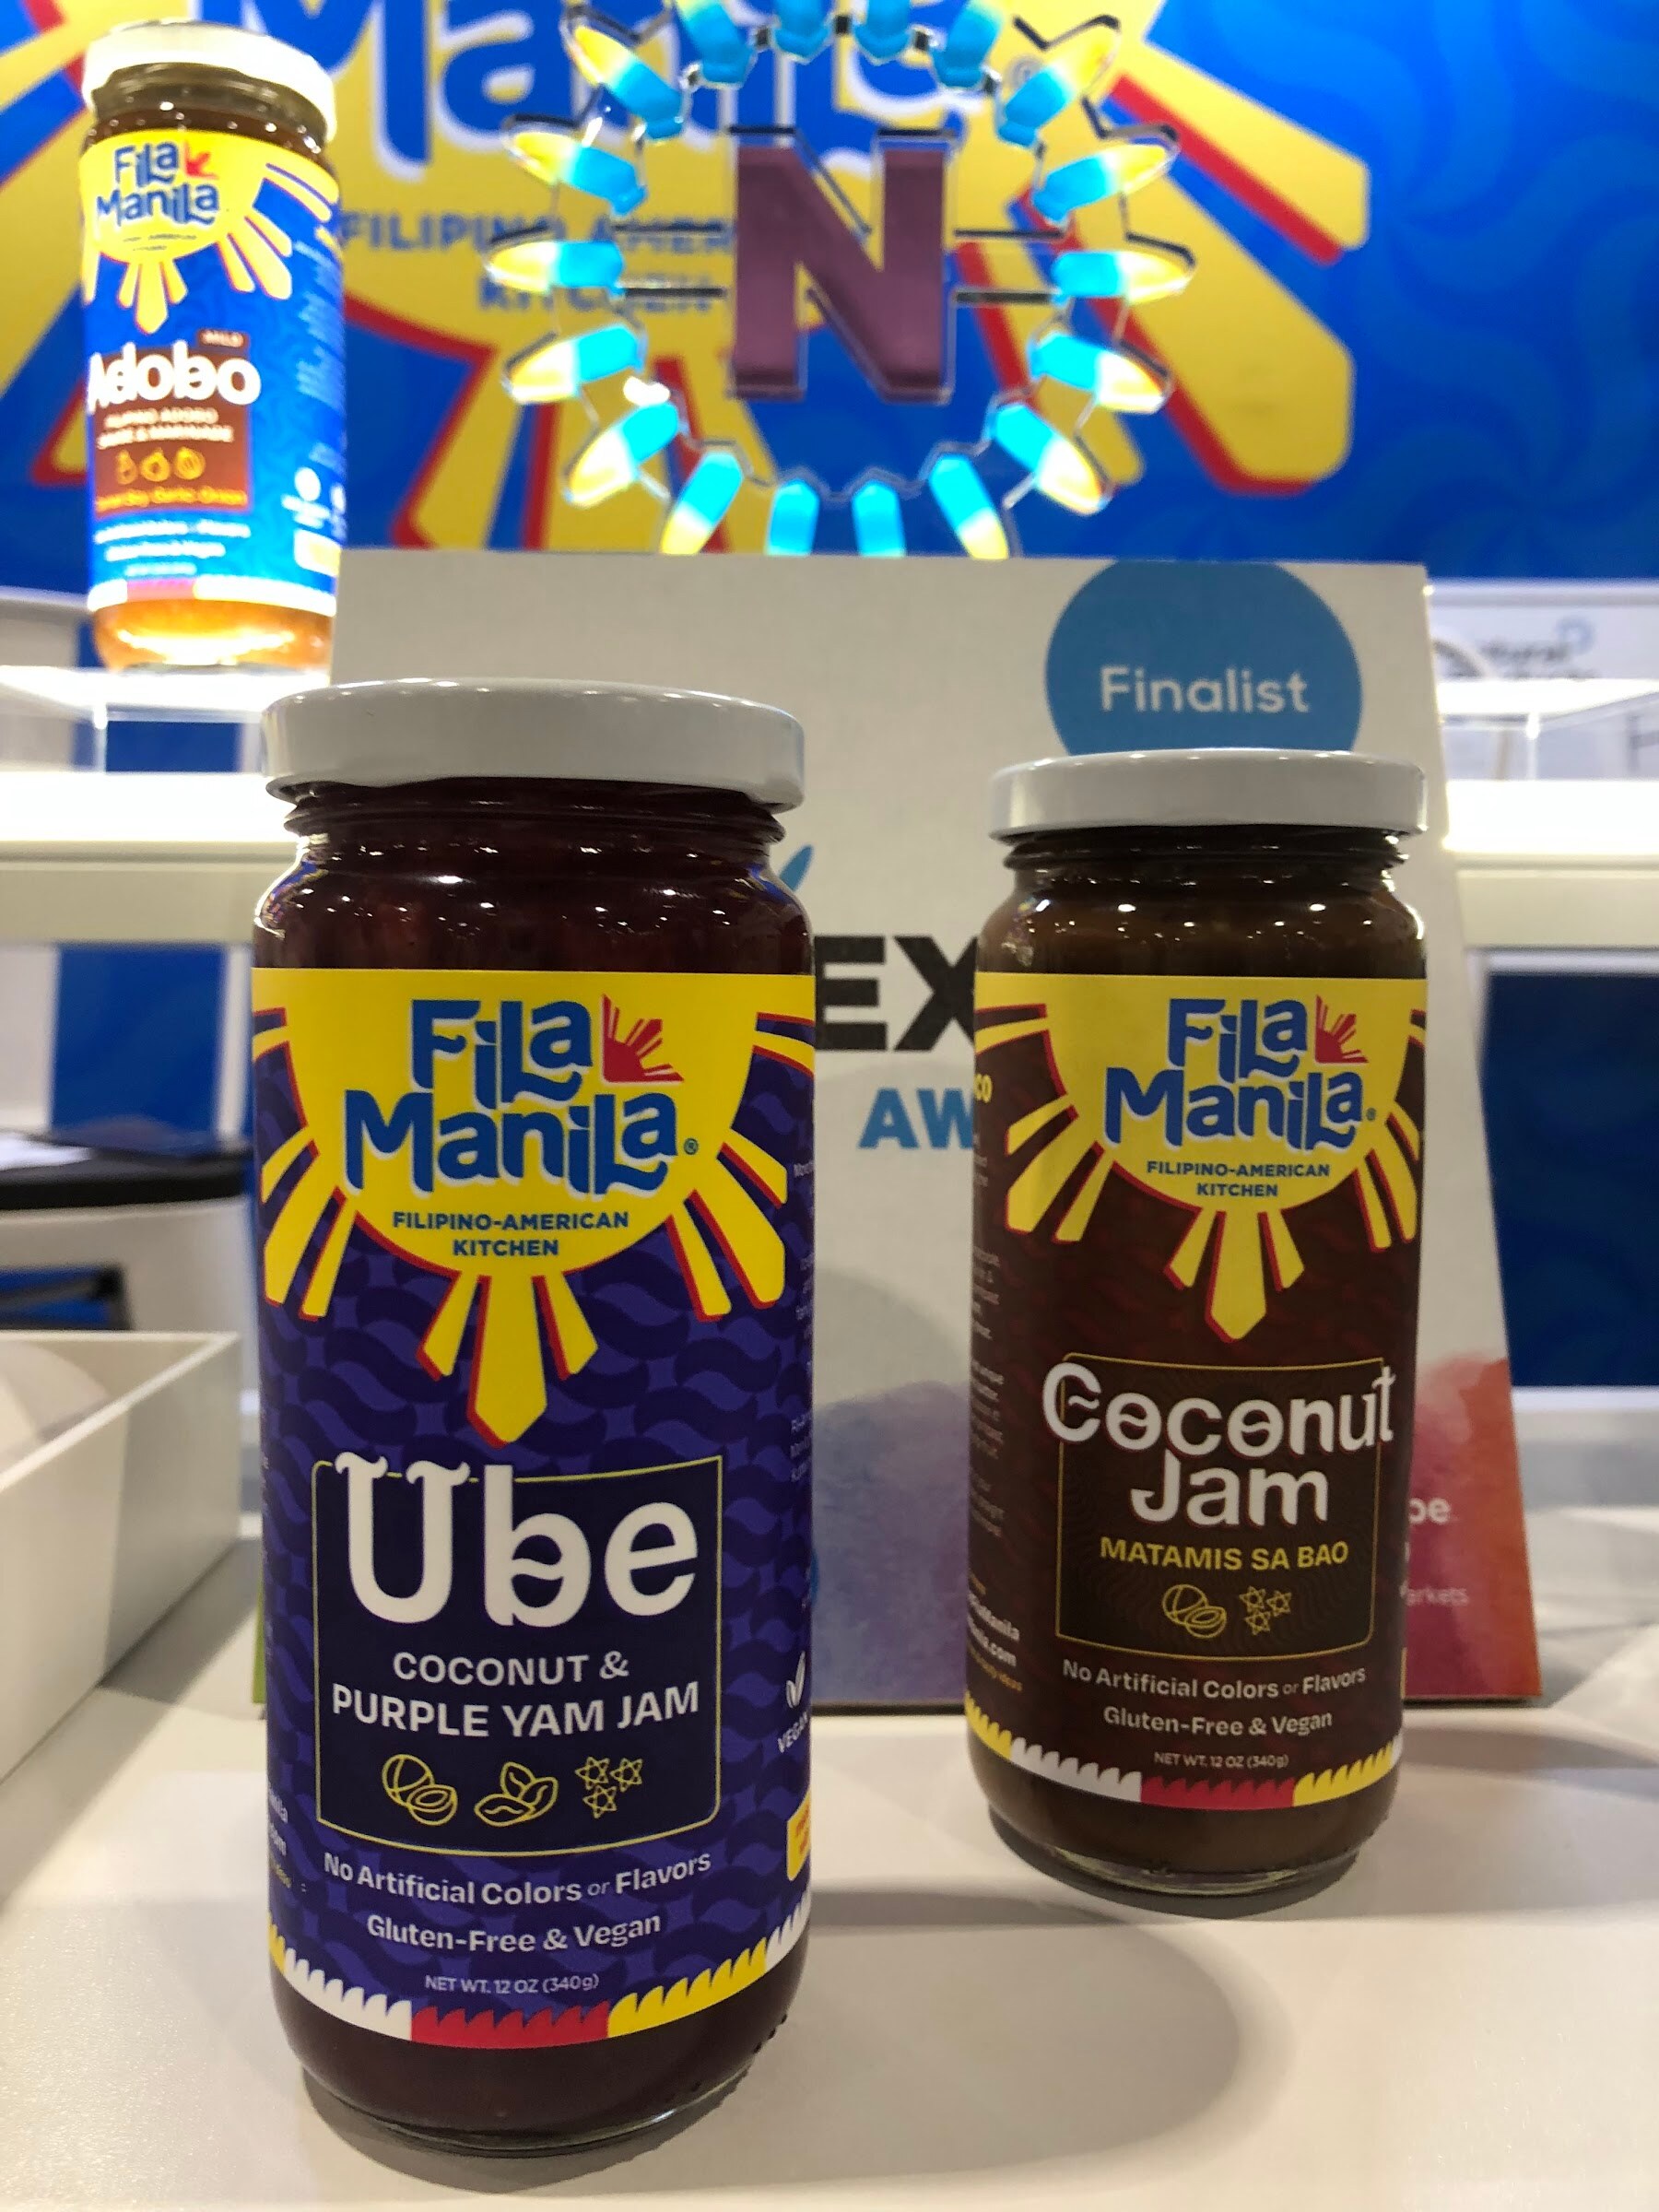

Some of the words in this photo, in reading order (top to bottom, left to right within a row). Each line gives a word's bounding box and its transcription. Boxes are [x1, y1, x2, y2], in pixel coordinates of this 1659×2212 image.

[1100, 666, 1311, 714] Finalist
[1146, 1160, 1331, 1178] FILIPINO-AMERICAN
[1196, 1182, 1279, 1197] KITCHEN
[393, 1210, 630, 1231] FILIPINO-AMERICAN
[452, 1239, 559, 1257] KITCHEN
[1042, 1361, 1396, 1459] Coconut
[1130, 1448, 1329, 1527] Jam
[335, 1452, 700, 1628] Ube
[1100, 1535, 1243, 1571] MATAMIS
[1251, 1547, 1290, 1571] SA
[1298, 1540, 1349, 1569] BAO
[393, 1652, 590, 1687] COCONUT
[599, 1650, 630, 1680] &
[1063, 1659, 1093, 1683] No
[1096, 1668, 1198, 1699] Artificial
[1203, 1679, 1280, 1700] Colors
[1282, 1683, 1300, 1696] or
[1302, 1665, 1367, 1696] Flavors
[333, 1682, 490, 1738] PURPLE
[502, 1699, 606, 1738] YAM
[617, 1680, 700, 1730] JAM
[1103, 1706, 1244, 1736] Gluten-Free
[1248, 1717, 1267, 1735] &
[1271, 1711, 1334, 1737] Vegan
[1153, 1751, 1180, 1767] NET
[1209, 1753, 1224, 1768] 12
[1225, 1754, 1244, 1768] OZ
[1246, 1752, 1289, 1770] (340g)
[324, 1852, 354, 1882] No
[357, 1865, 475, 1905] Artificial
[481, 1880, 583, 1905] Colors
[587, 1882, 612, 1897] or
[616, 1853, 712, 1895] Flavors
[367, 1914, 536, 1953] Gluten-Free
[543, 1928, 569, 1951] &
[573, 1914, 662, 1948] Vegan
[425, 1974, 457, 1991] NET
[494, 1979, 511, 1994] 12
[514, 1978, 539, 1994] OZ
[543, 1973, 600, 1994] (340g)
